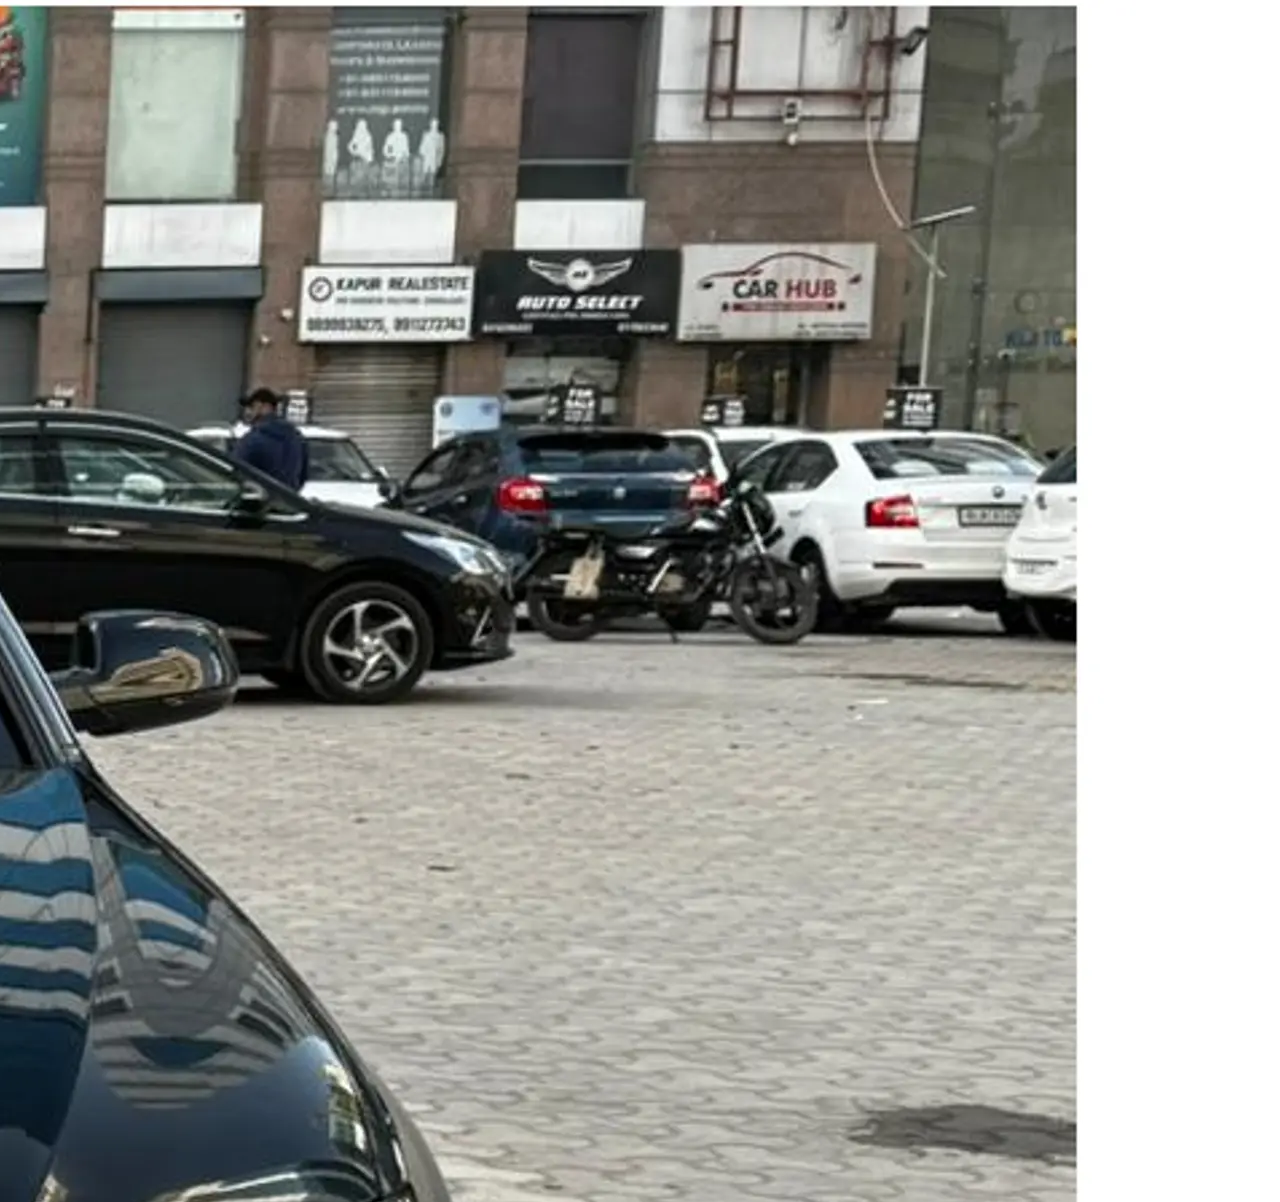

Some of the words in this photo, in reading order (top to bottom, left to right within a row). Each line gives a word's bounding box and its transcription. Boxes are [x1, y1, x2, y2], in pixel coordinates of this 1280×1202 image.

[336, 277, 381, 291] KAPUR
[388, 276, 468, 290] REALESTATE
[733, 279, 778, 298] CAR
[786, 278, 837, 298] HUB
[516, 295, 571, 310] AUTO
[574, 295, 643, 310] SELECT
